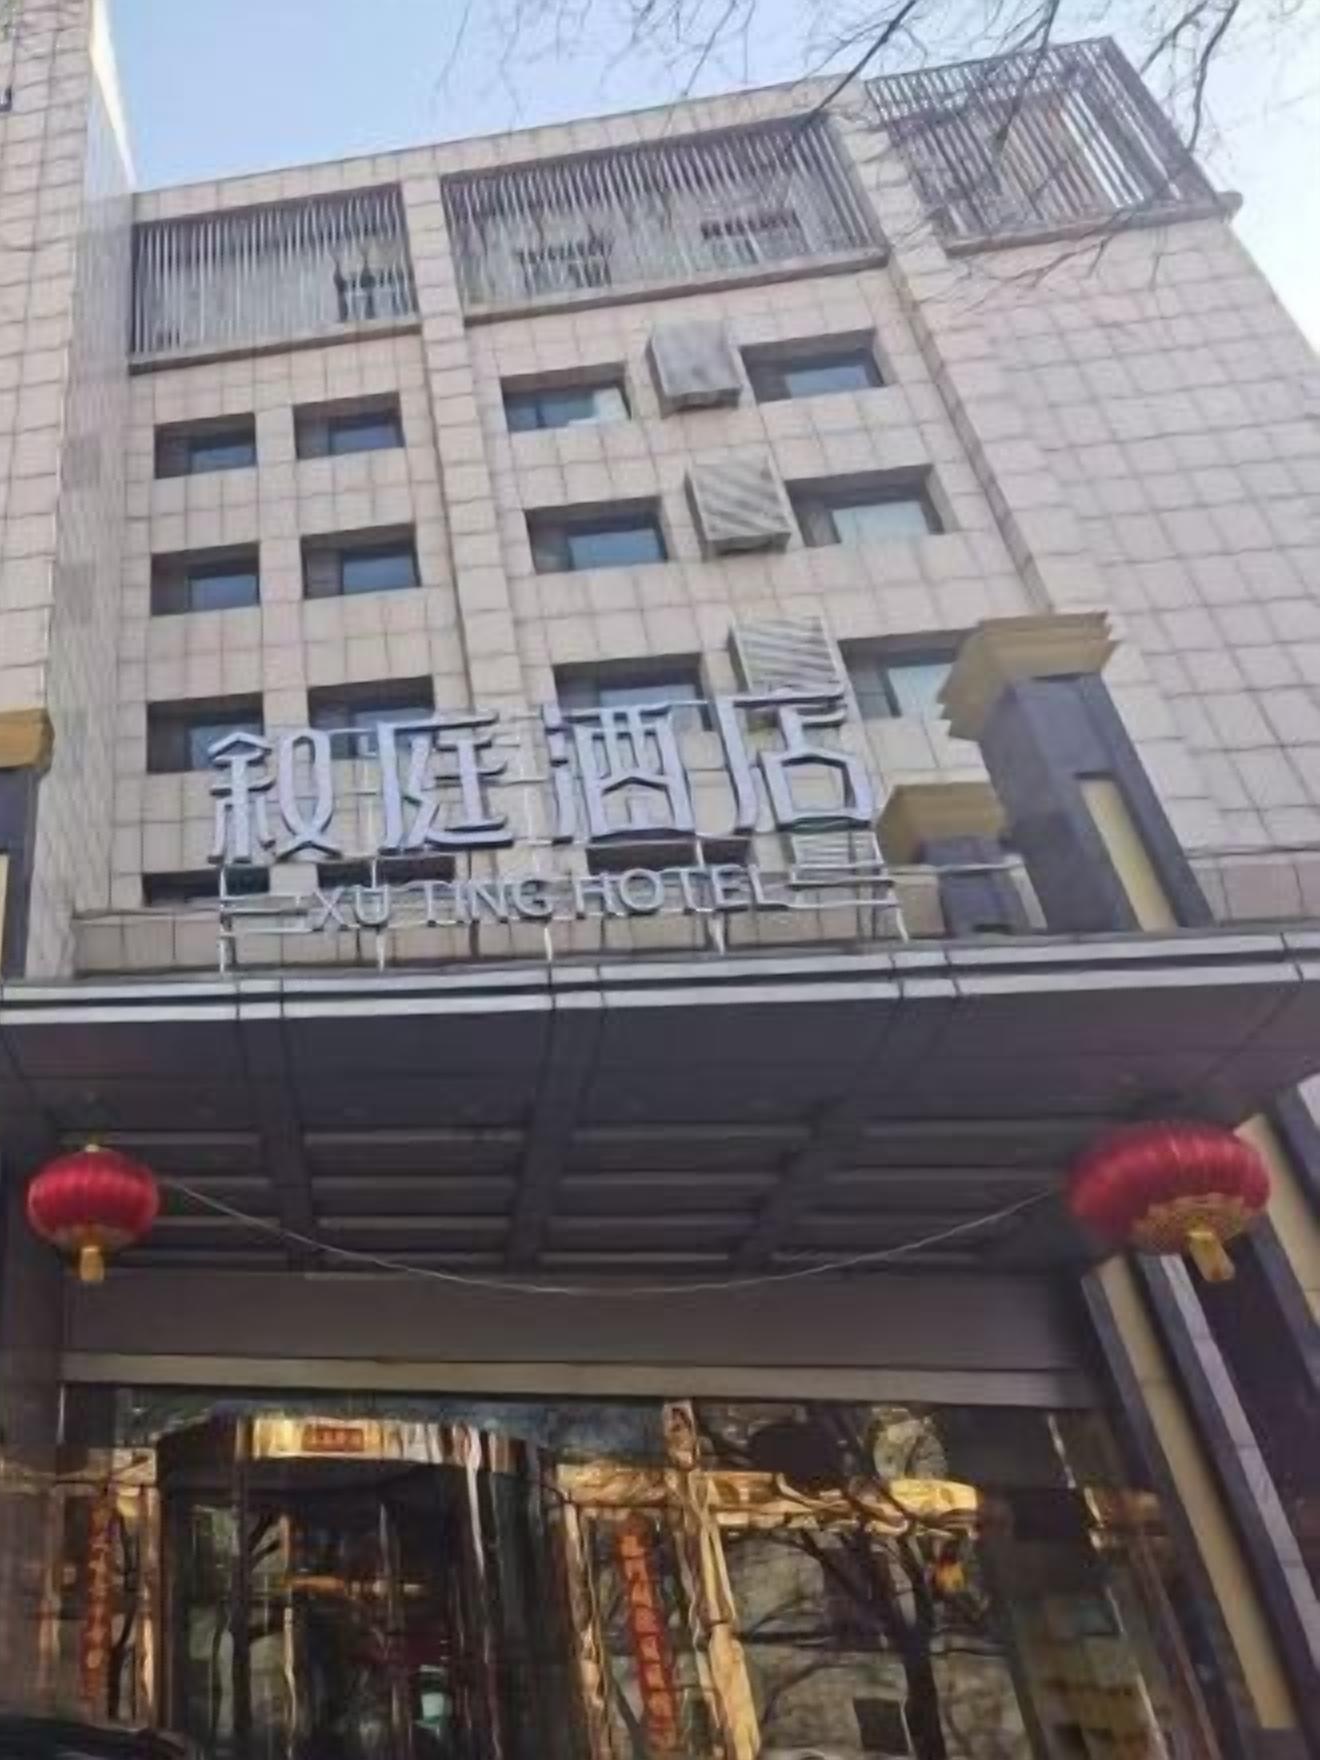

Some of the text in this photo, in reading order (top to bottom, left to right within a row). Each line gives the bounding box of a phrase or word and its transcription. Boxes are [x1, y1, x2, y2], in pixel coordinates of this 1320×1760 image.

[206, 690, 876, 864] 叙庭酒店
[312, 863, 788, 931] XU TING HOTEL
